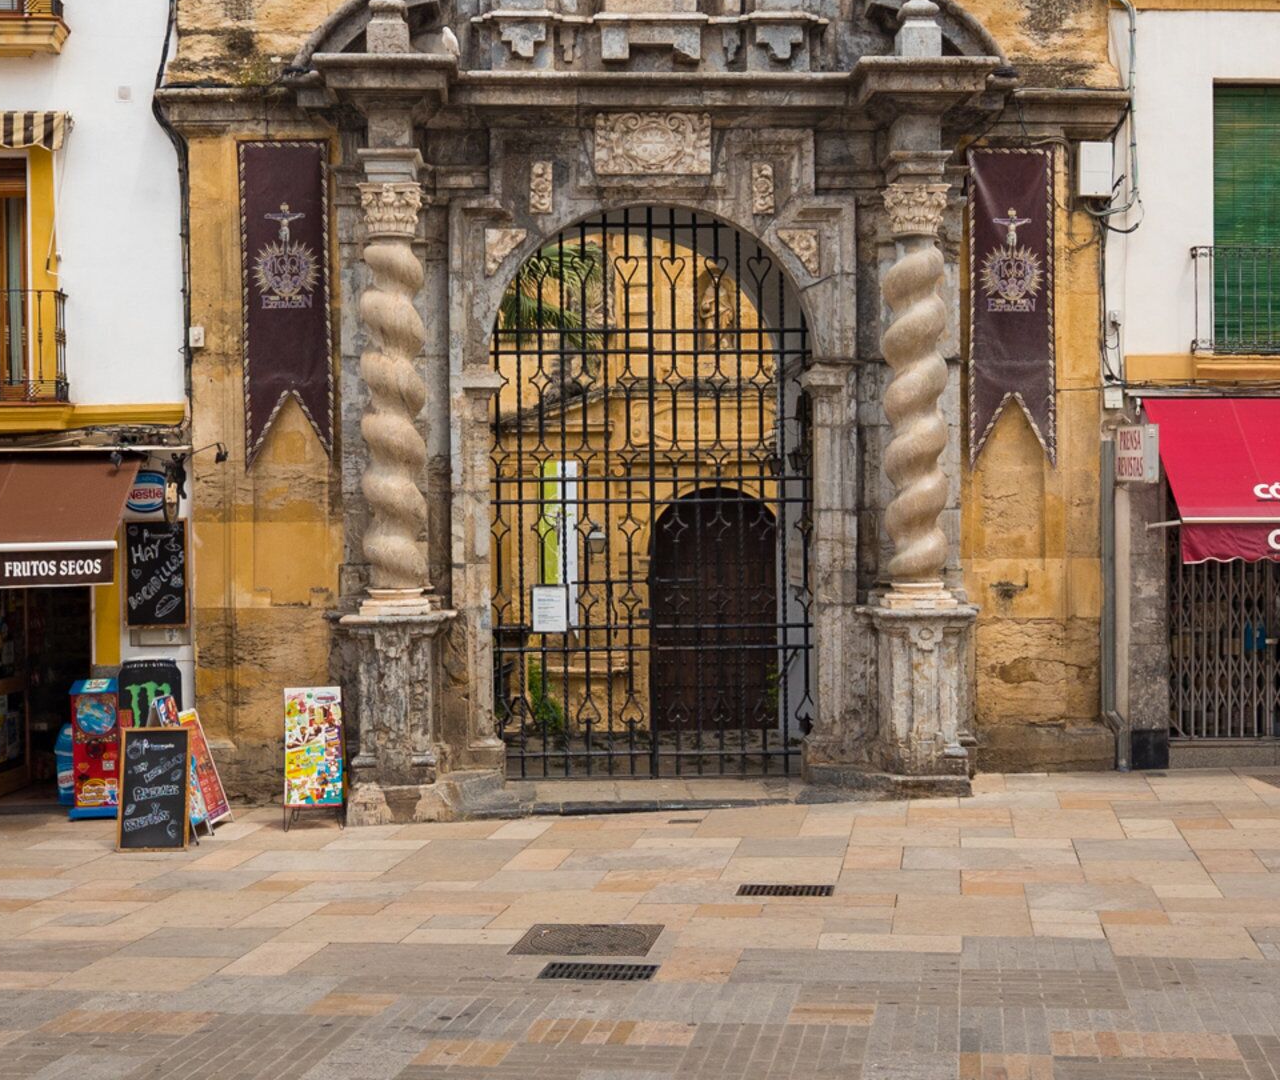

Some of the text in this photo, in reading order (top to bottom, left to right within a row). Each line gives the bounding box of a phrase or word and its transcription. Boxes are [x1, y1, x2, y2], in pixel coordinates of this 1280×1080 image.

[1120, 430, 1141, 450] PRENSA
[1118, 456, 1144, 477] REVISTAS
[131, 539, 161, 564] HAY
[4, 558, 102, 577] FRUTOS SECOS
